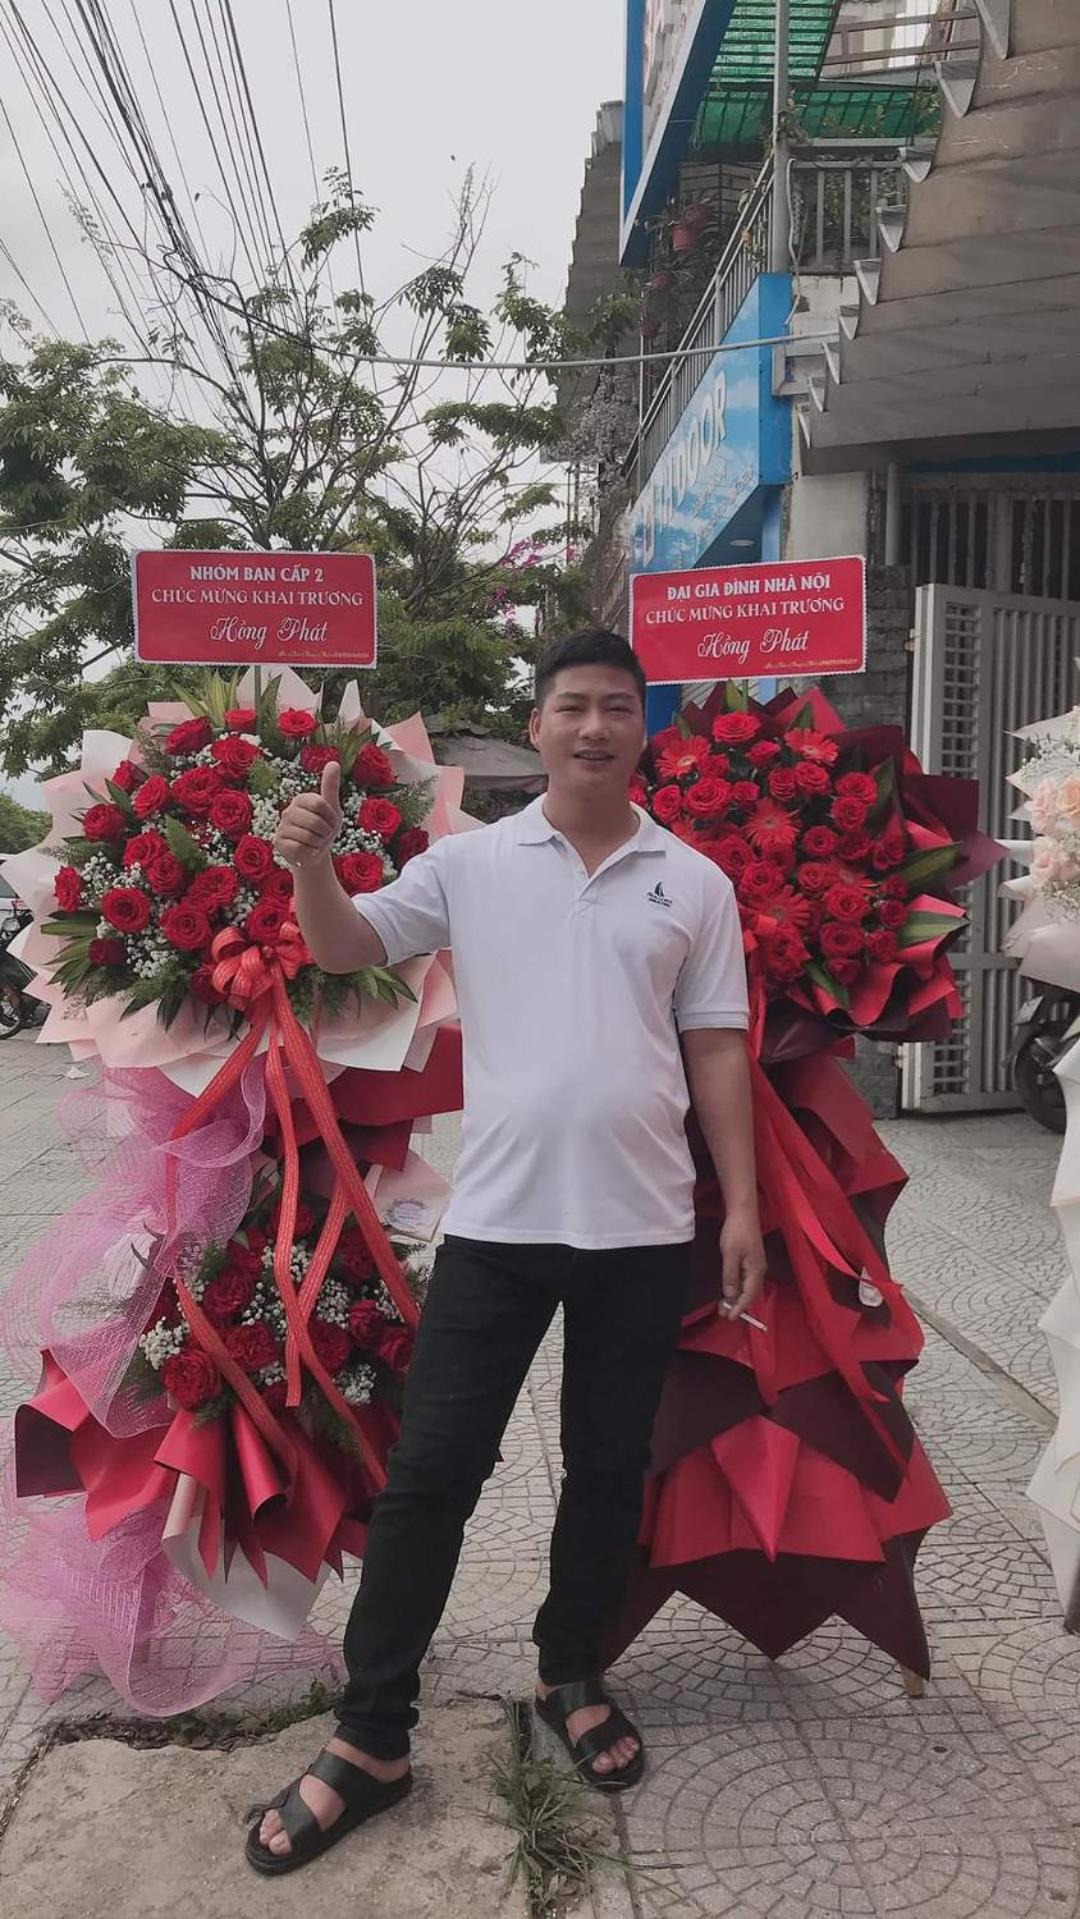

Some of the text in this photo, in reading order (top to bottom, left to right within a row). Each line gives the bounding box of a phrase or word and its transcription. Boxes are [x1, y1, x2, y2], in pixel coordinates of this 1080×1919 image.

[190, 563, 324, 584] NHÓM BẠN CẤP 2
[667, 572, 830, 602] ĐẠI GIA ĐÌNH NHÀ NỘI
[151, 586, 363, 606] CHÚC MỪNG KHAI TRƯƠNG
[646, 607, 685, 624] CHÚC
[737, 602, 776, 618] KHAI
[780, 597, 845, 615] TRƯƠNG
[210, 615, 329, 649] Hồng Phát
[697, 631, 751, 664] Hồng
[759, 627, 810, 654] Phát
